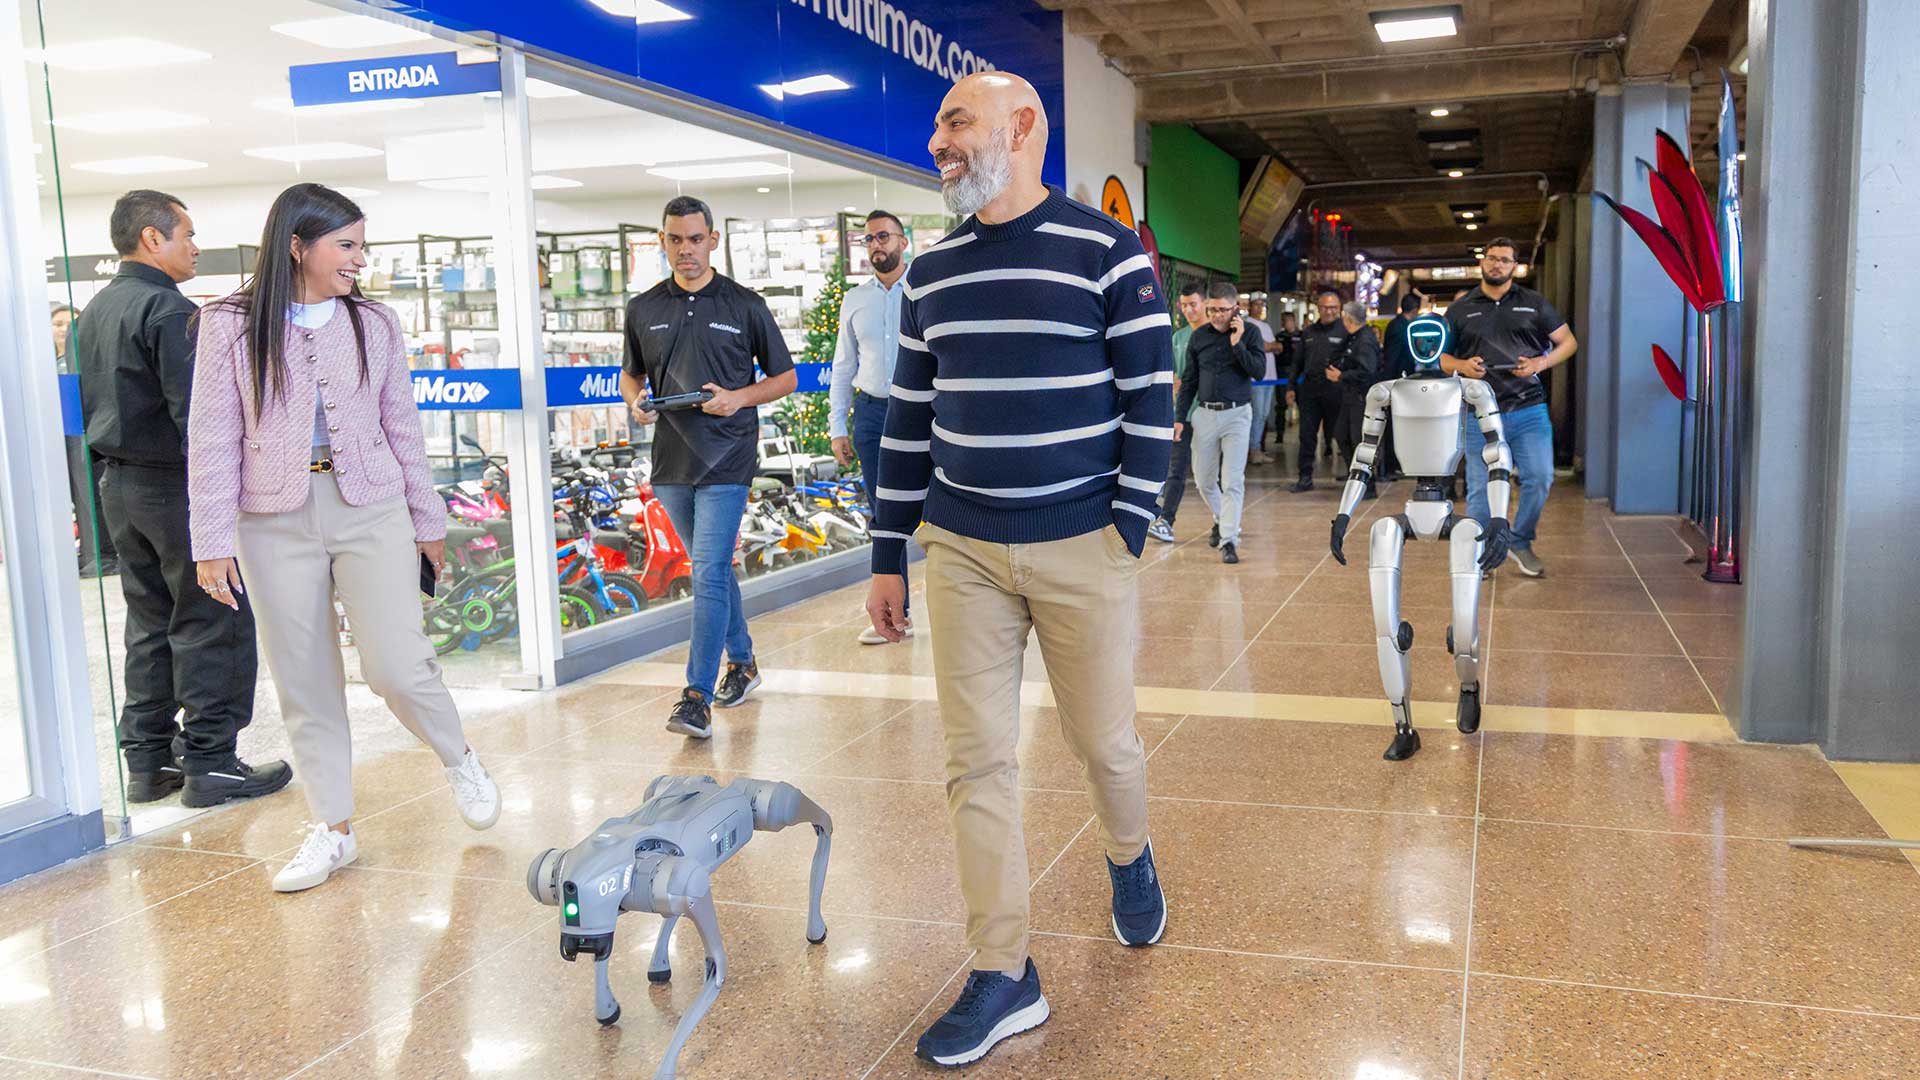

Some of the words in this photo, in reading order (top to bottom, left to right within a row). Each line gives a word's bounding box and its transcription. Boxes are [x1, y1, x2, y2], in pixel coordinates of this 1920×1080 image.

[348, 64, 440, 93] ENTRADA
[411, 376, 479, 403] iMax
[599, 877, 617, 897] 02
